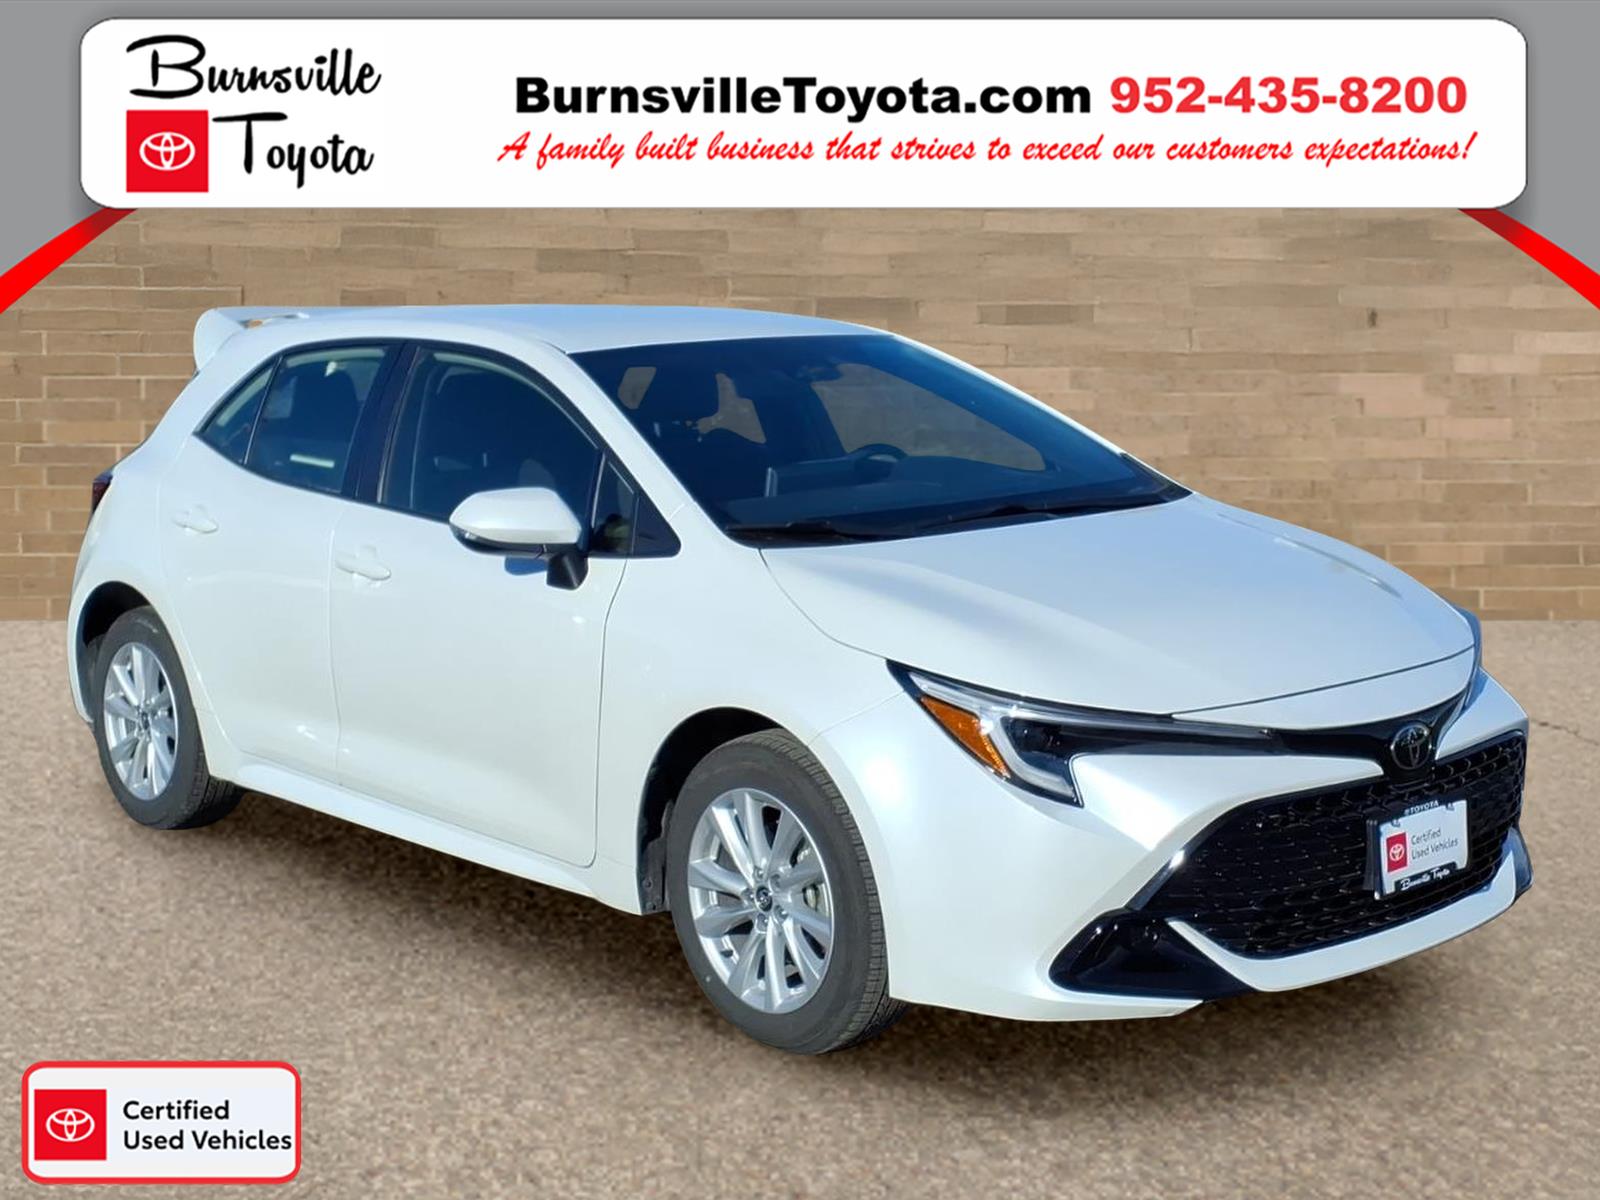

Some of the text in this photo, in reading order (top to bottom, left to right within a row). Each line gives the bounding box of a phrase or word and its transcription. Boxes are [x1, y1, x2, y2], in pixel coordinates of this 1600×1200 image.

[1411, 828, 1441, 845] Certified
[1411, 838, 1459, 860] Used Vehicles
